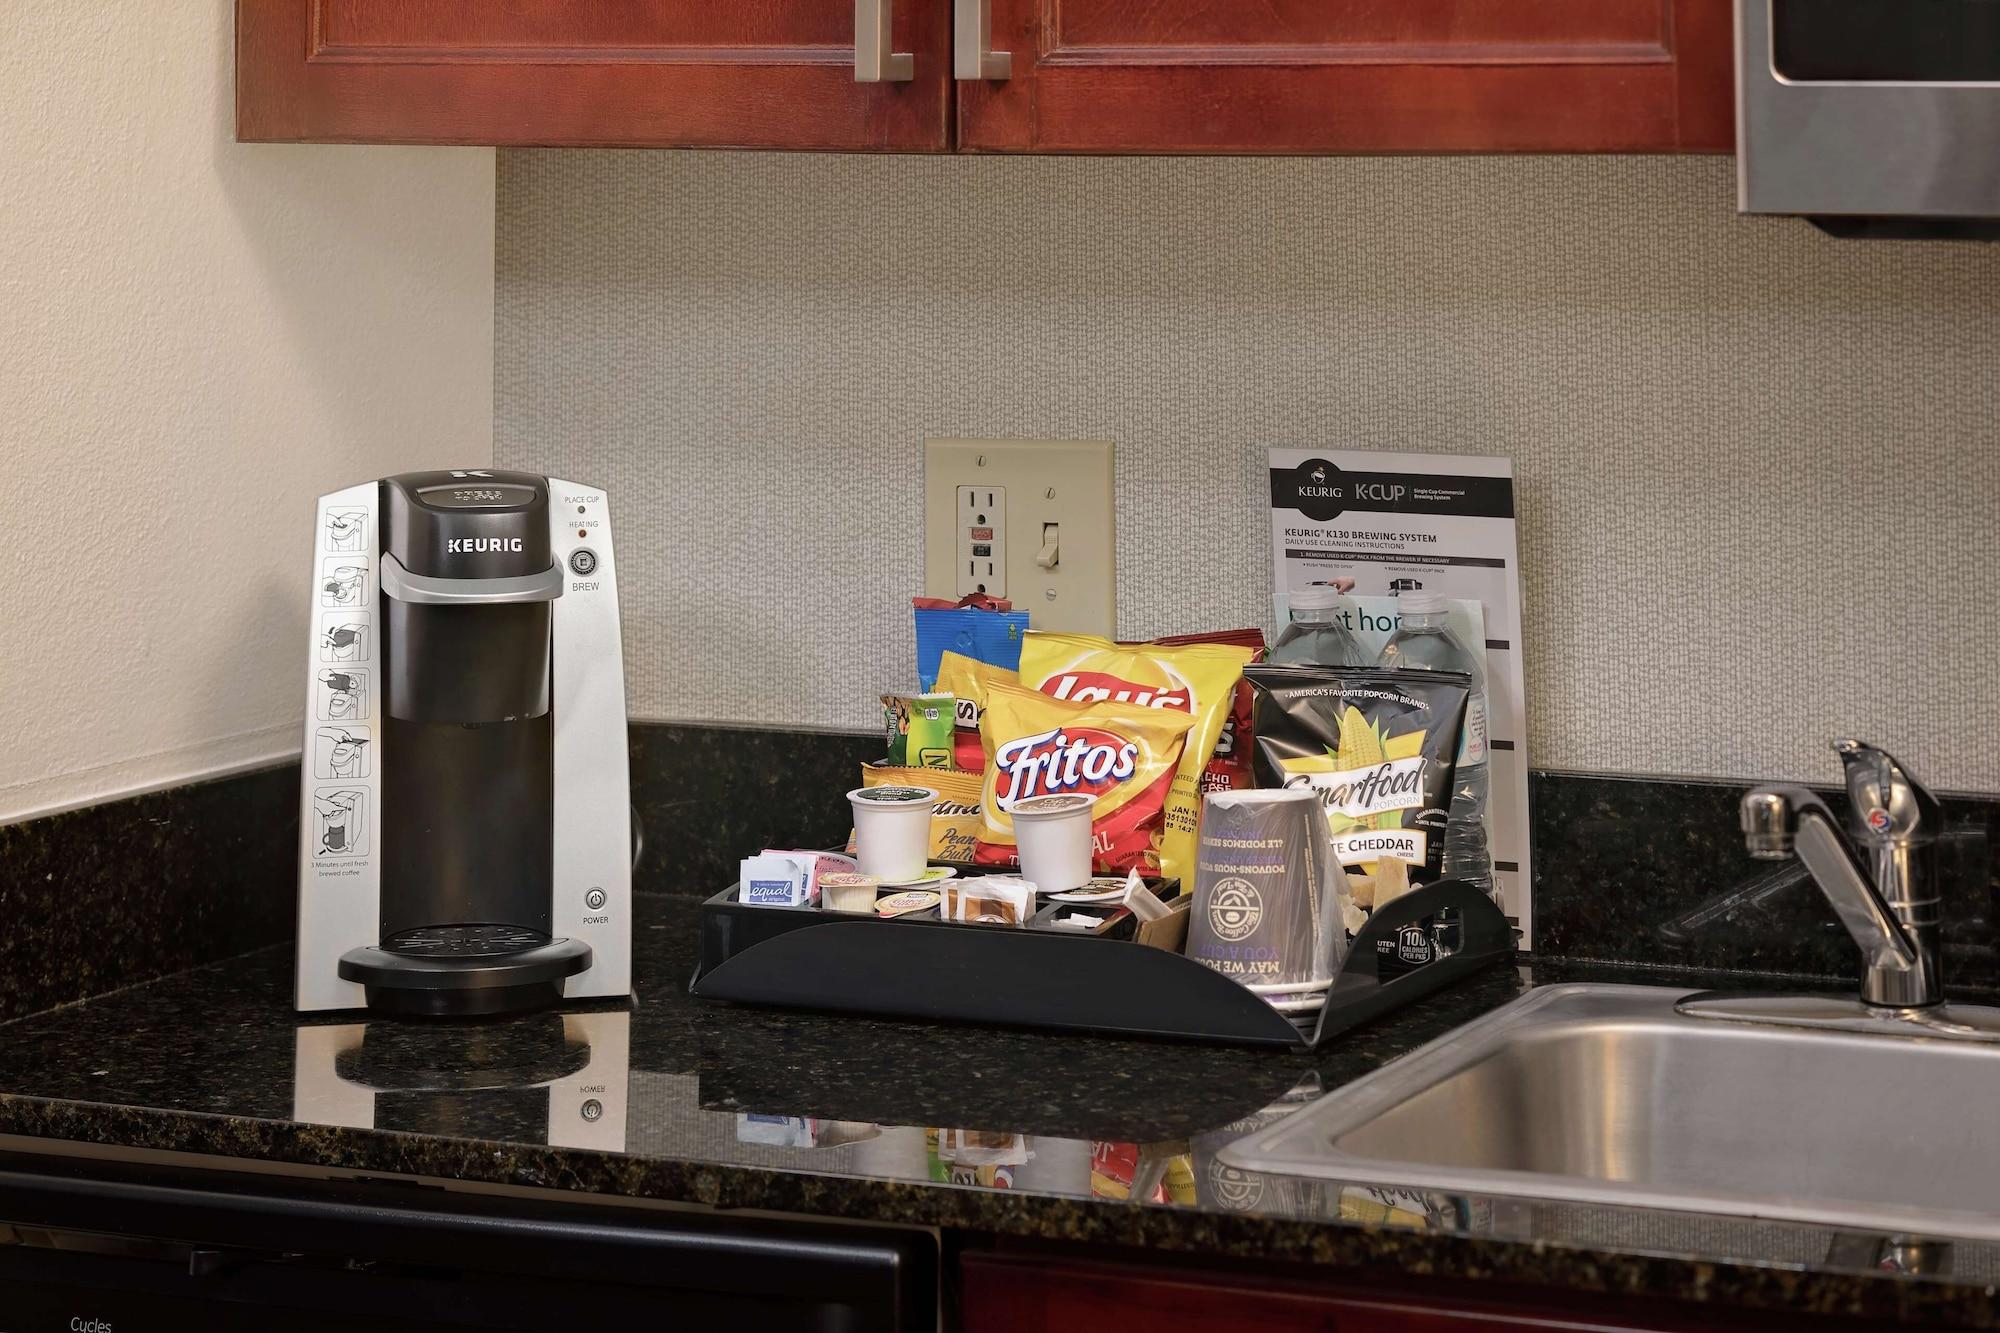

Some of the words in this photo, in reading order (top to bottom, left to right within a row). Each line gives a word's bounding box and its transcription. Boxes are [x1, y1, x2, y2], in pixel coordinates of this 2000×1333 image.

[1298, 486, 1343, 498] KEURIG
[565, 496, 585, 504] PLACE
[586, 495, 600, 503] CUP
[569, 520, 599, 528] HEATING
[1326, 530, 1349, 539] K130
[1352, 531, 1396, 541] BREWING
[1399, 533, 1437, 543] SYSTEM
[448, 538, 523, 553] KEURIG
[1319, 540, 1353, 548] CLEANING
[1354, 541, 1405, 549] INSTRUCTIONS
[572, 582, 600, 592] BREW
[1289, 688, 1329, 699] AMERICA'S
[1329, 689, 1363, 697] FAVORITE
[1364, 689, 1399, 702] POPCORN
[1399, 696, 1426, 709] BRAND
[995, 727, 1139, 812] Fritos
[1374, 796, 1420, 811] POPCORN
[1172, 806, 1189, 815] JAN
[1222, 838, 1266, 849] PODEMOS
[1348, 838, 1414, 852] CHEDDAR
[1214, 863, 1285, 874] POUVONS-NOUS
[750, 881, 792, 902] equal
[583, 916, 609, 924] POWER
[1402, 946, 1428, 954] CALORIES
[1403, 952, 1414, 960] PER
[1223, 960, 1246, 973] WE
[1249, 961, 1280, 973] MAY
[70, 1316, 112, 1333] Cycles
